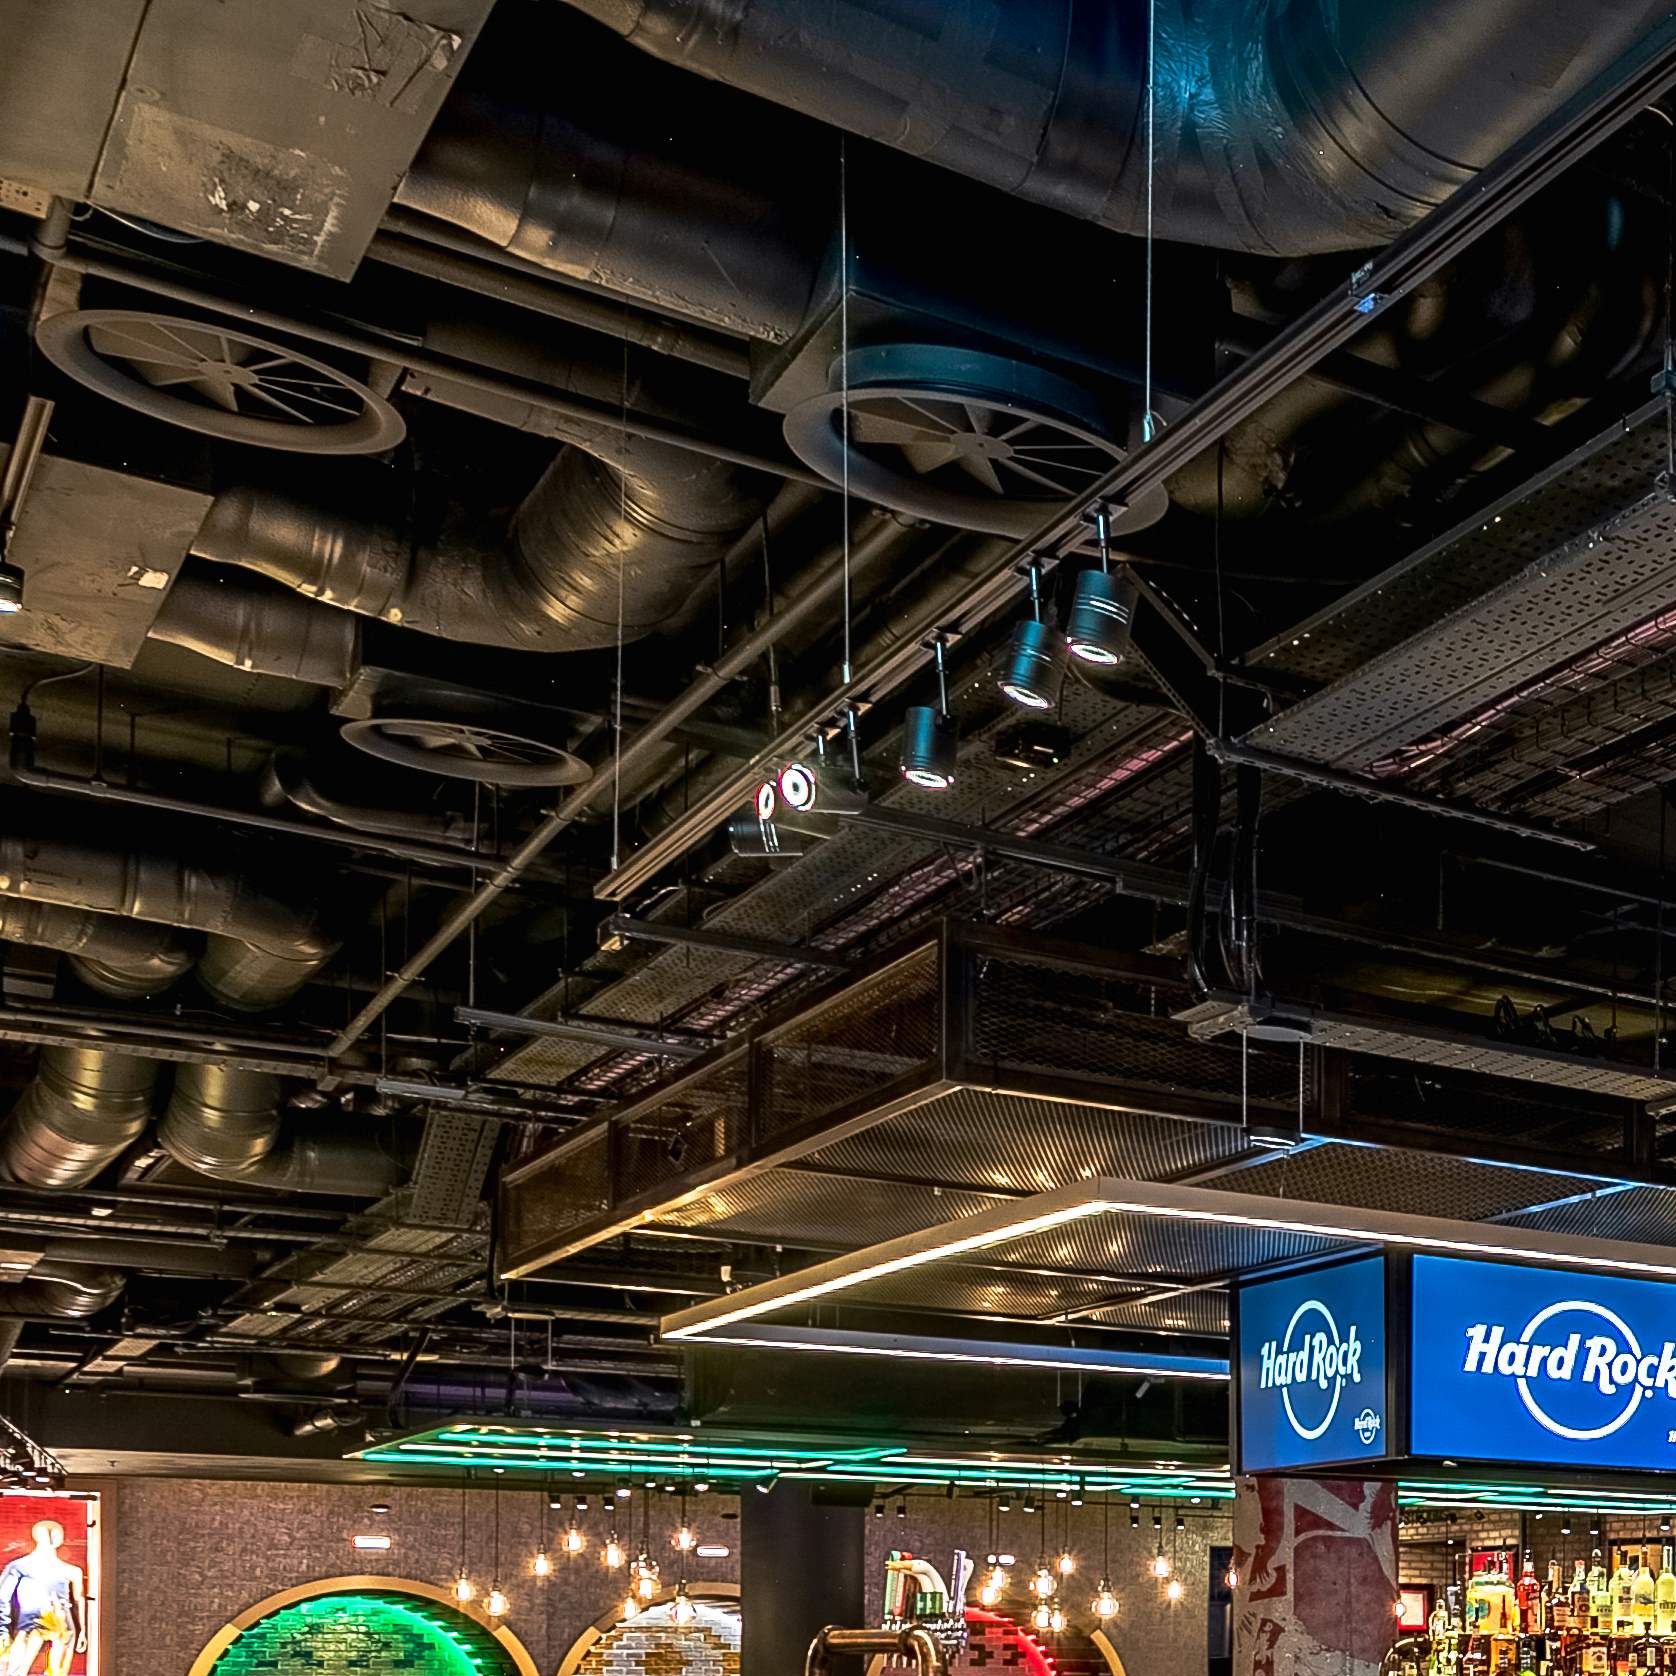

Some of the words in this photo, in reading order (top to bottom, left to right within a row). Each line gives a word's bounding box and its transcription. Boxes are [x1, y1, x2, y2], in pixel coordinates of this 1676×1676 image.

[1260, 1334, 1311, 1389] Hard
[1311, 1325, 1362, 1390] Rock
[1463, 1323, 1582, 1381] Hard
